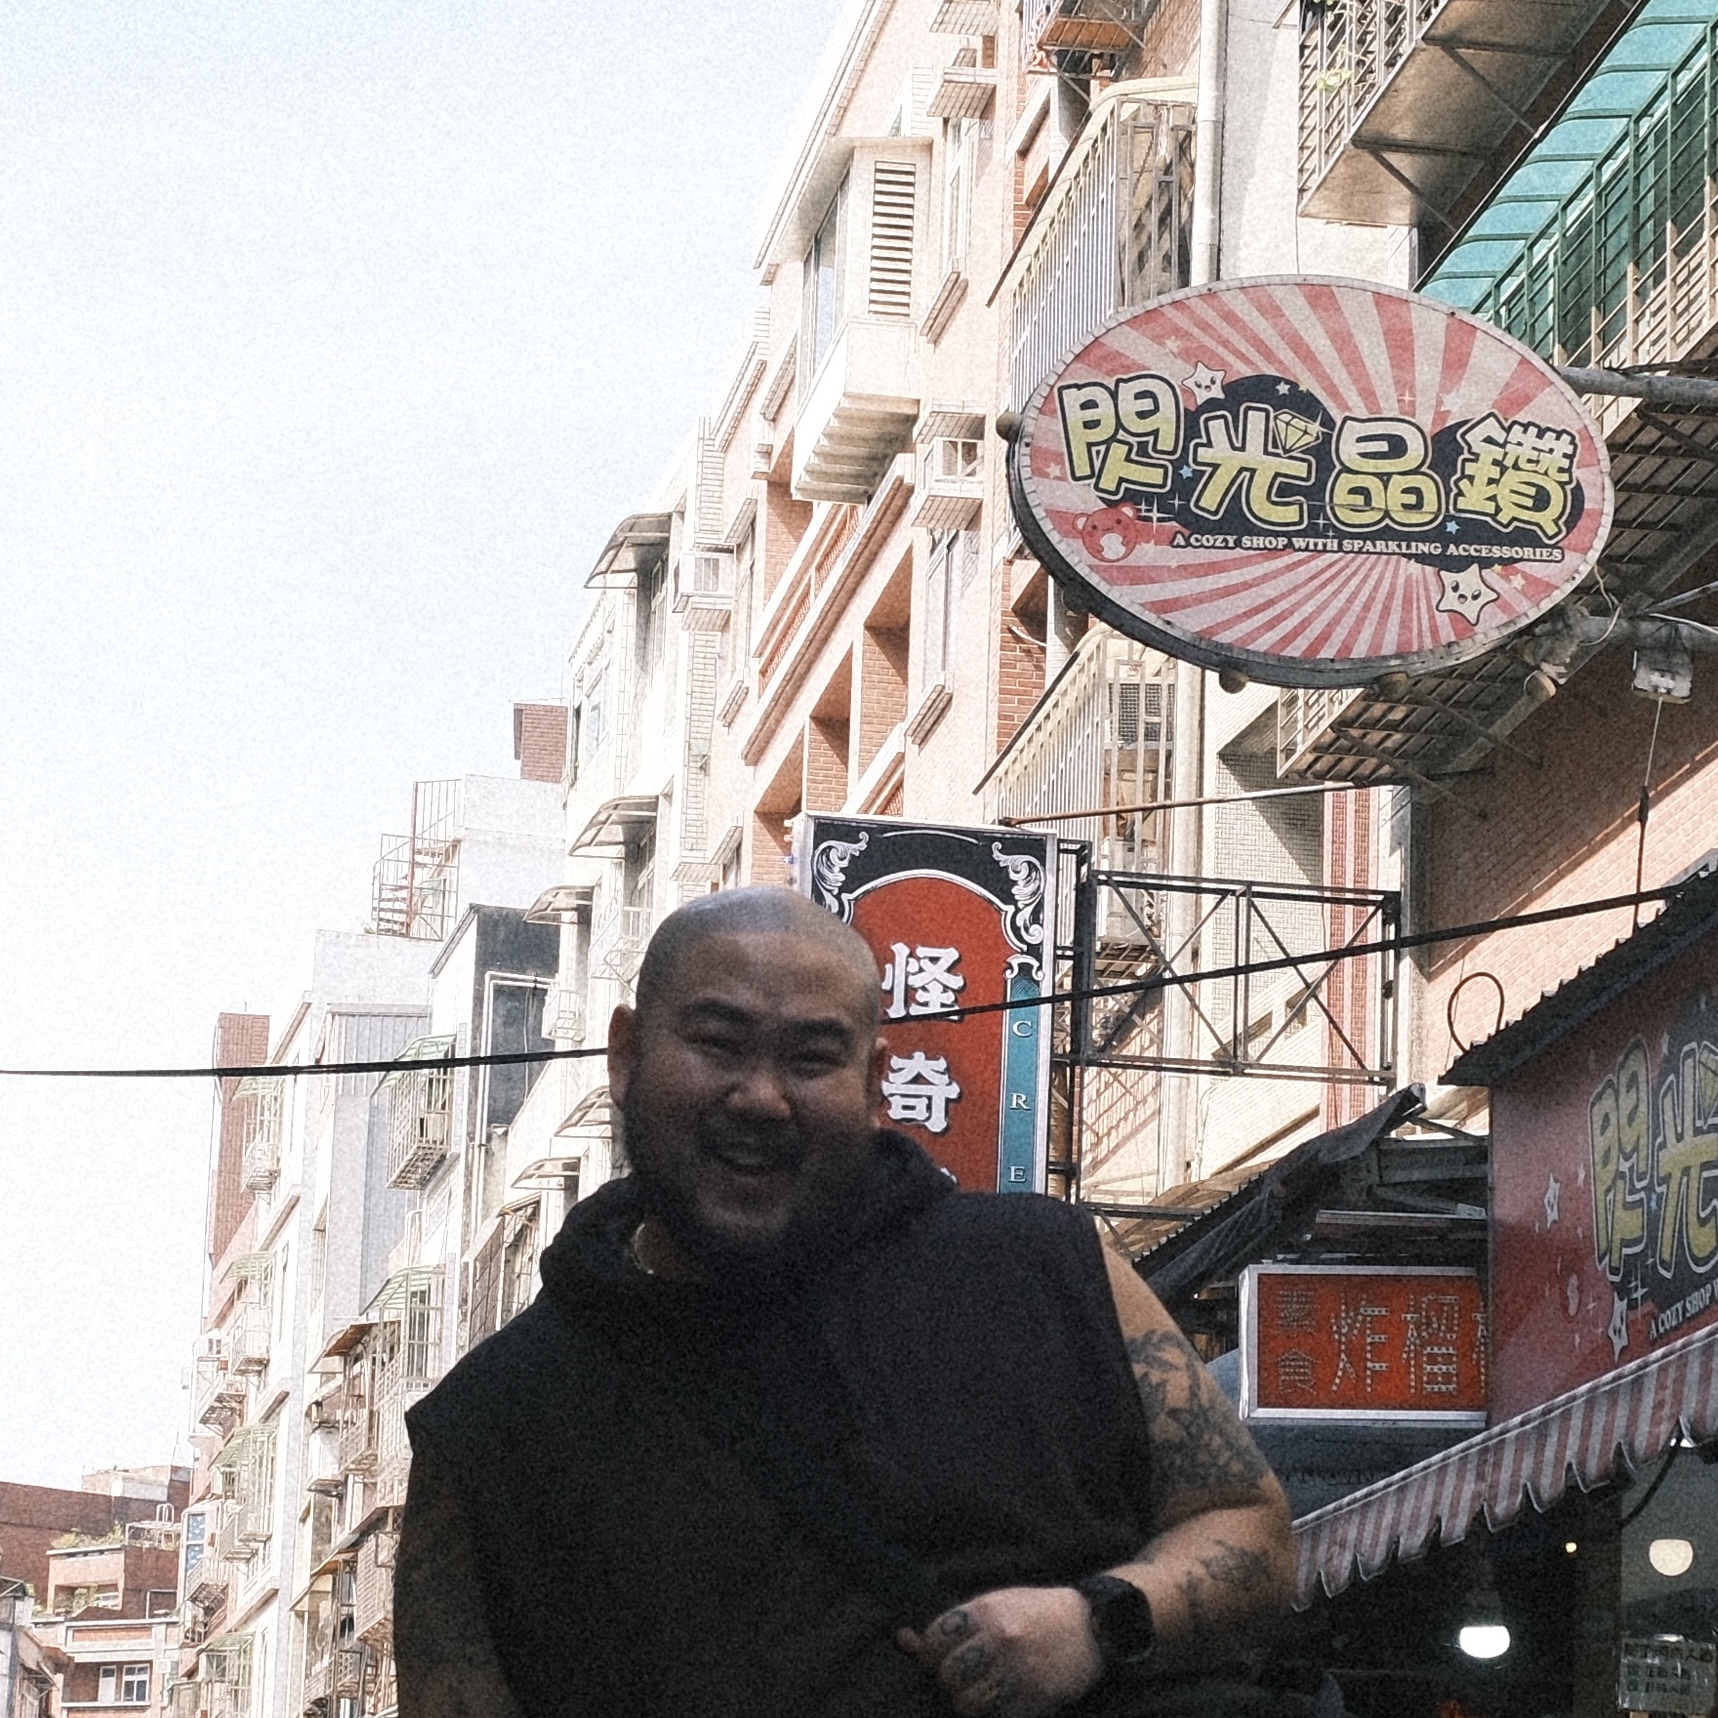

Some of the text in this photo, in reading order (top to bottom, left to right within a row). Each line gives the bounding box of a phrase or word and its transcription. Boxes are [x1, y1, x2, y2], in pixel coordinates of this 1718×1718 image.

[1059, 376, 1577, 543] 閃光晶鑽
[1172, 533, 1564, 562] A COZY SHOP WITH SPARKLING ACCESSORIES
[881, 941, 965, 1184] 怪奇
[1649, 1318, 1657, 1340] A
[1658, 1298, 1685, 1330] COZY
[1685, 1285, 1712, 1318] SHOP
